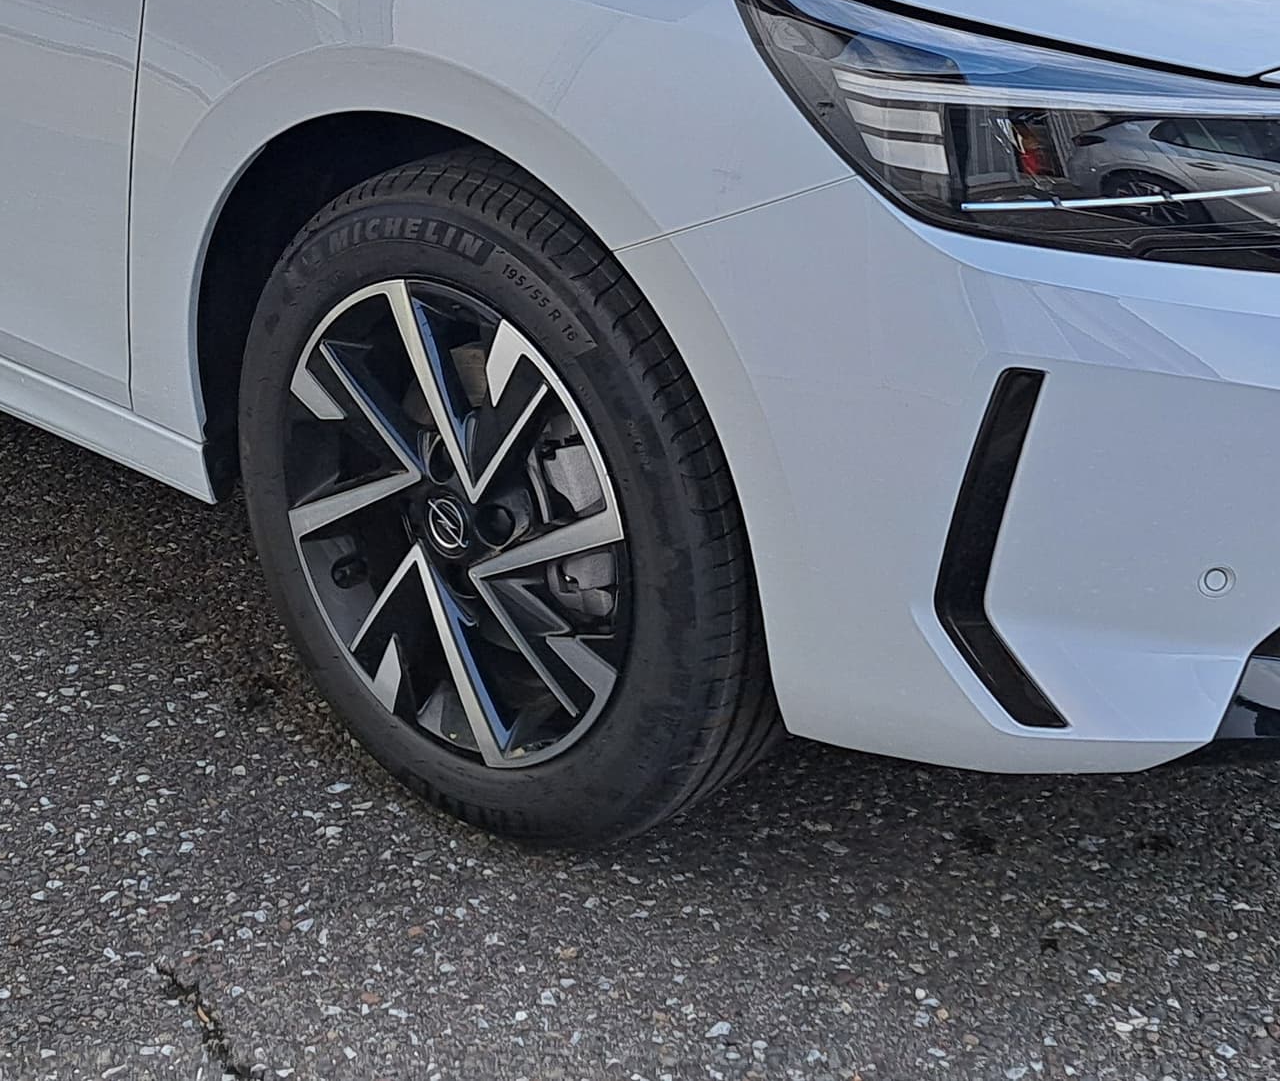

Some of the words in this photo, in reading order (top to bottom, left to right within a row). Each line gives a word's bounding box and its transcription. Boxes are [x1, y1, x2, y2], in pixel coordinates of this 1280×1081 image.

[328, 218, 484, 257] MICHELIN
[502, 264, 551, 308] 195/55
[548, 308, 562, 323] R
[562, 323, 578, 342] 16
